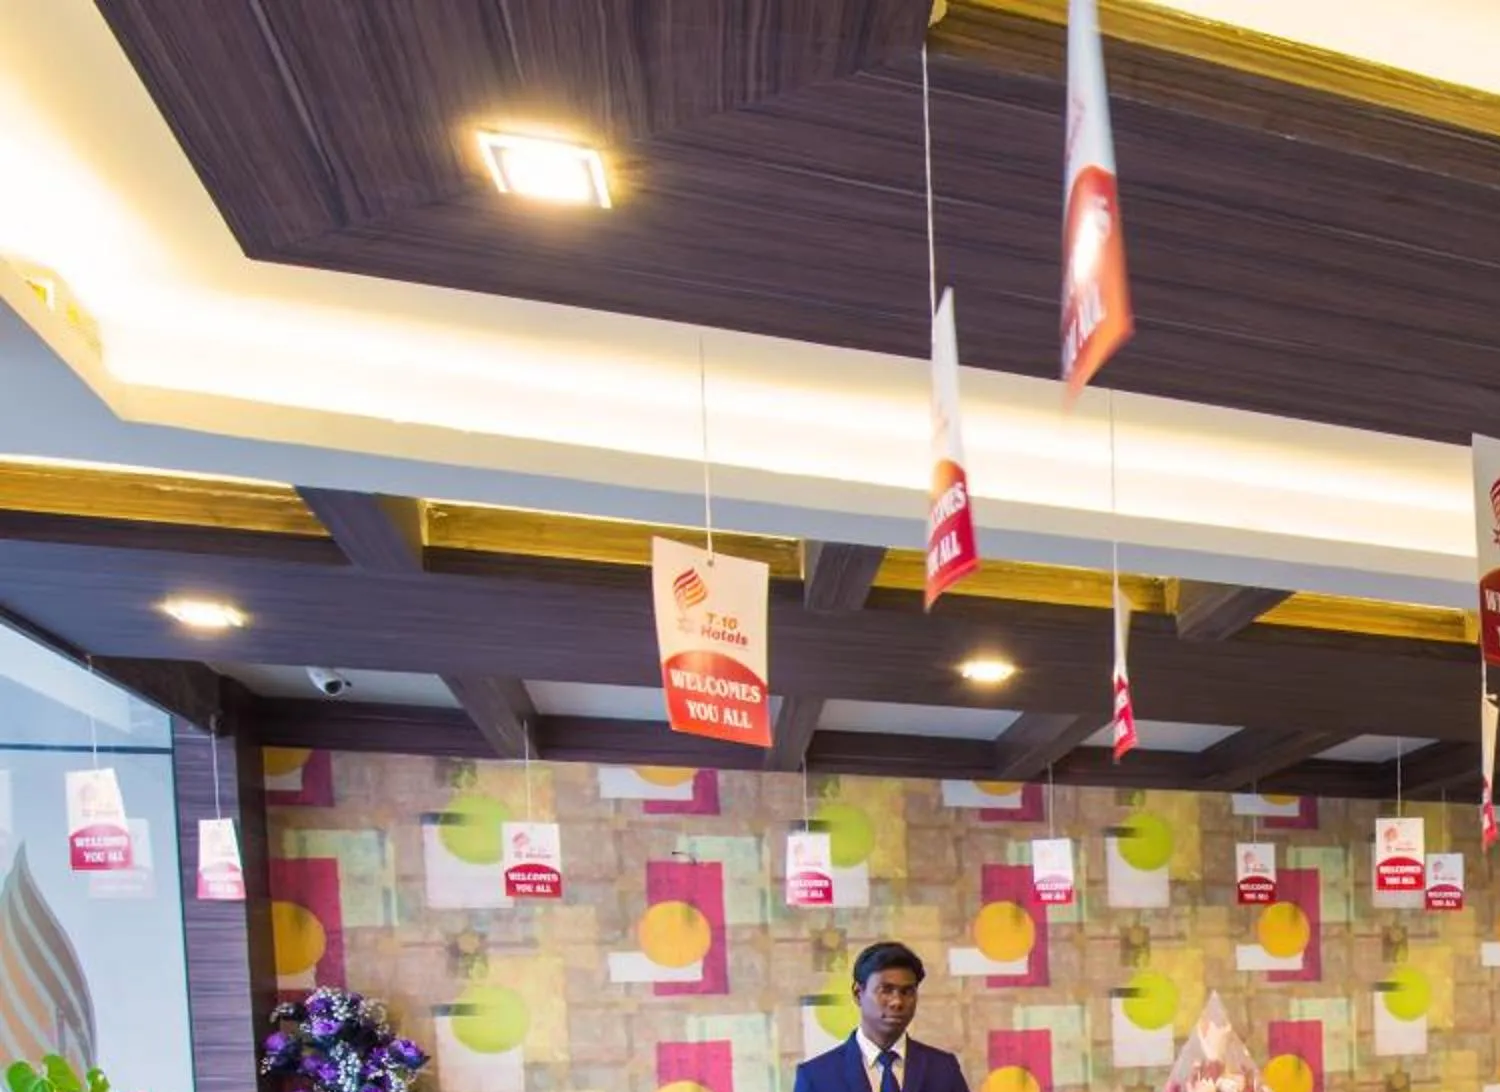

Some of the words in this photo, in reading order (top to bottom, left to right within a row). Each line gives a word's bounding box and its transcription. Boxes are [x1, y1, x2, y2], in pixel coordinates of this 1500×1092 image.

[706, 612, 738, 630] T-10
[701, 624, 749, 646] Hotels
[669, 669, 761, 703] WELCOMES
[686, 699, 719, 723] YOU
[722, 708, 752, 729] ALL
